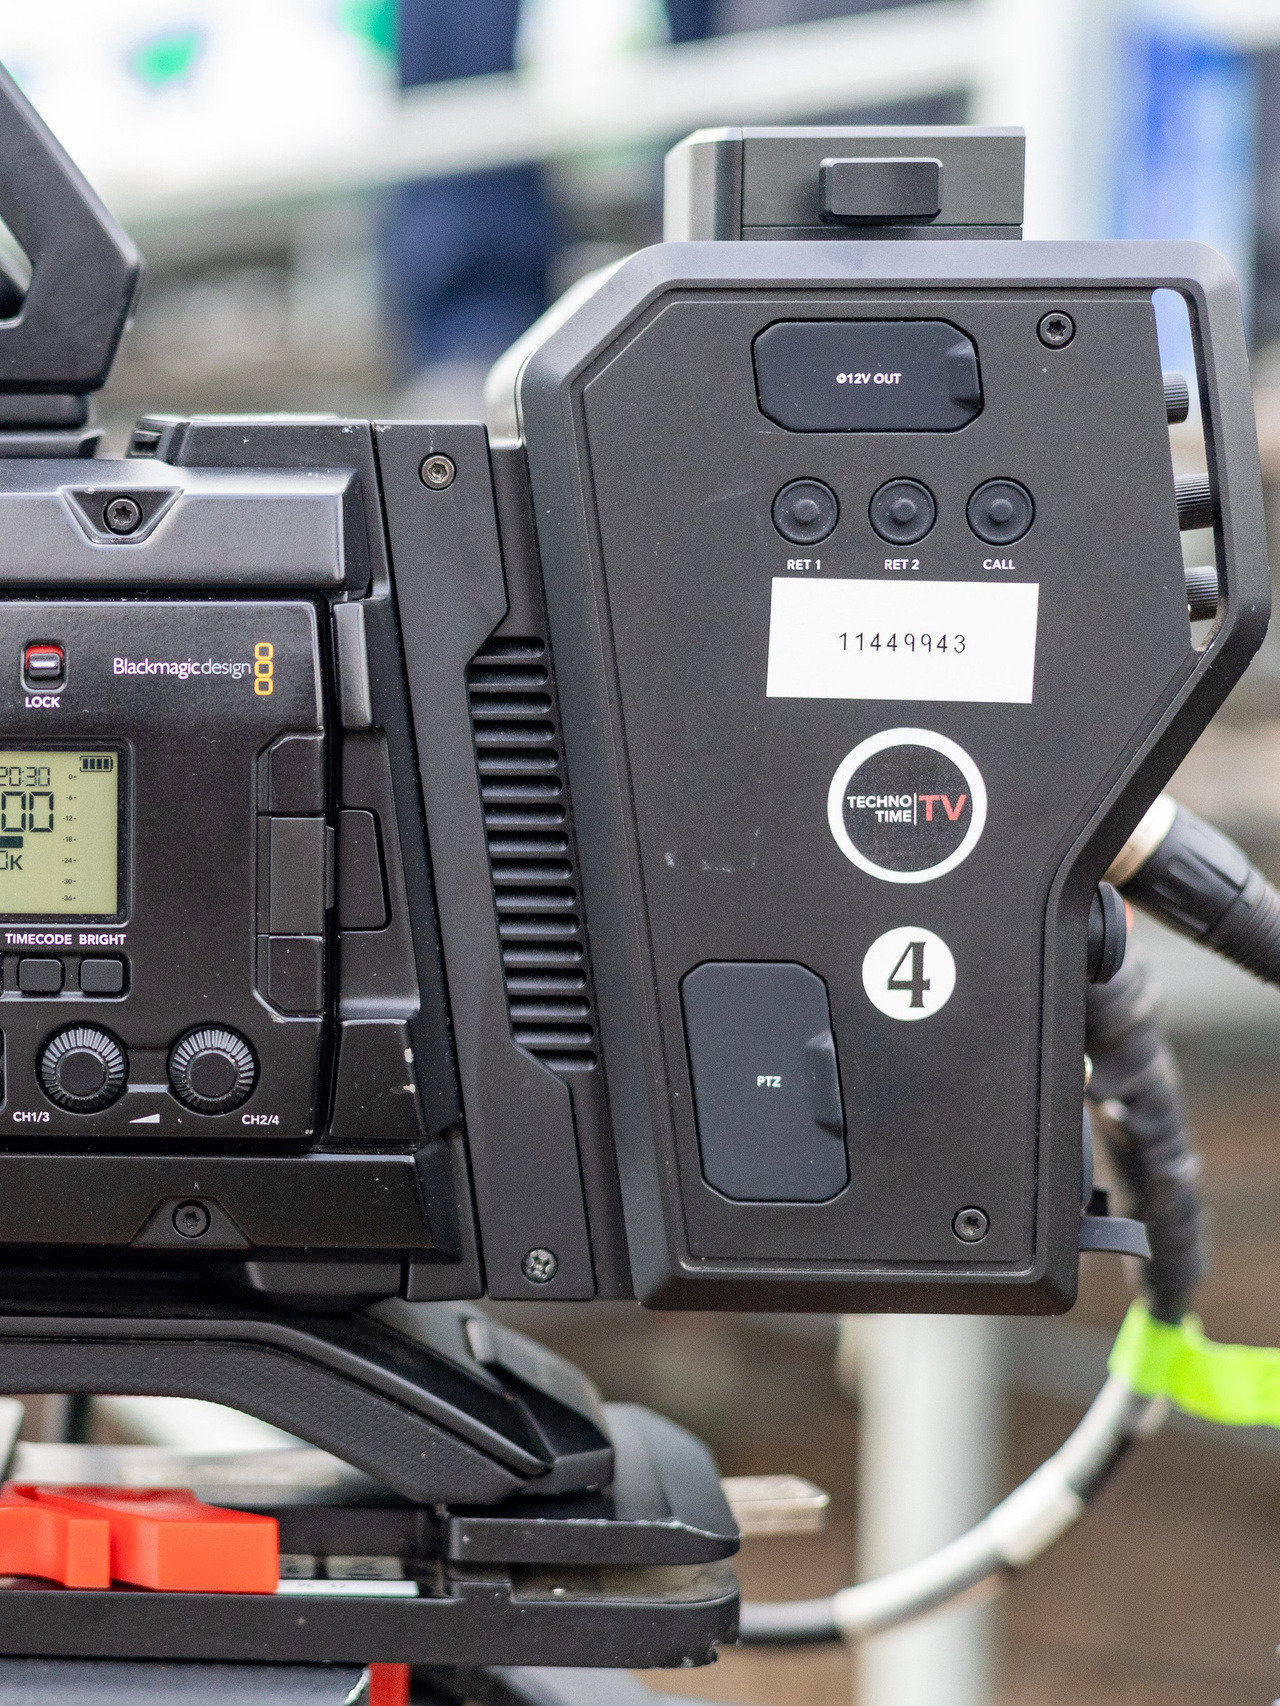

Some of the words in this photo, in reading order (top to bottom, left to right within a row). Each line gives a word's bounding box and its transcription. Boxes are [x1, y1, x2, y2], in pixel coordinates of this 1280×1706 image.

[873, 373, 902, 384] OUT
[787, 560, 812, 570] RET
[815, 560, 821, 570] 1
[884, 560, 909, 570] RET
[911, 560, 920, 570] 2
[983, 560, 1016, 571] CALL
[839, 632, 966, 653] 11449943
[25, 697, 60, 708] LOCK
[847, 795, 912, 809] TECHNO
[919, 794, 967, 821] TV
[875, 810, 912, 823] TIME
[5, 933, 73, 945] TIMECODE
[79, 934, 127, 946] BRIGHT
[887, 942, 930, 1009] 4
[757, 1076, 781, 1087] PTZ
[13, 1112, 50, 1123] CH1/3
[242, 1114, 280, 1126] CH2/4
